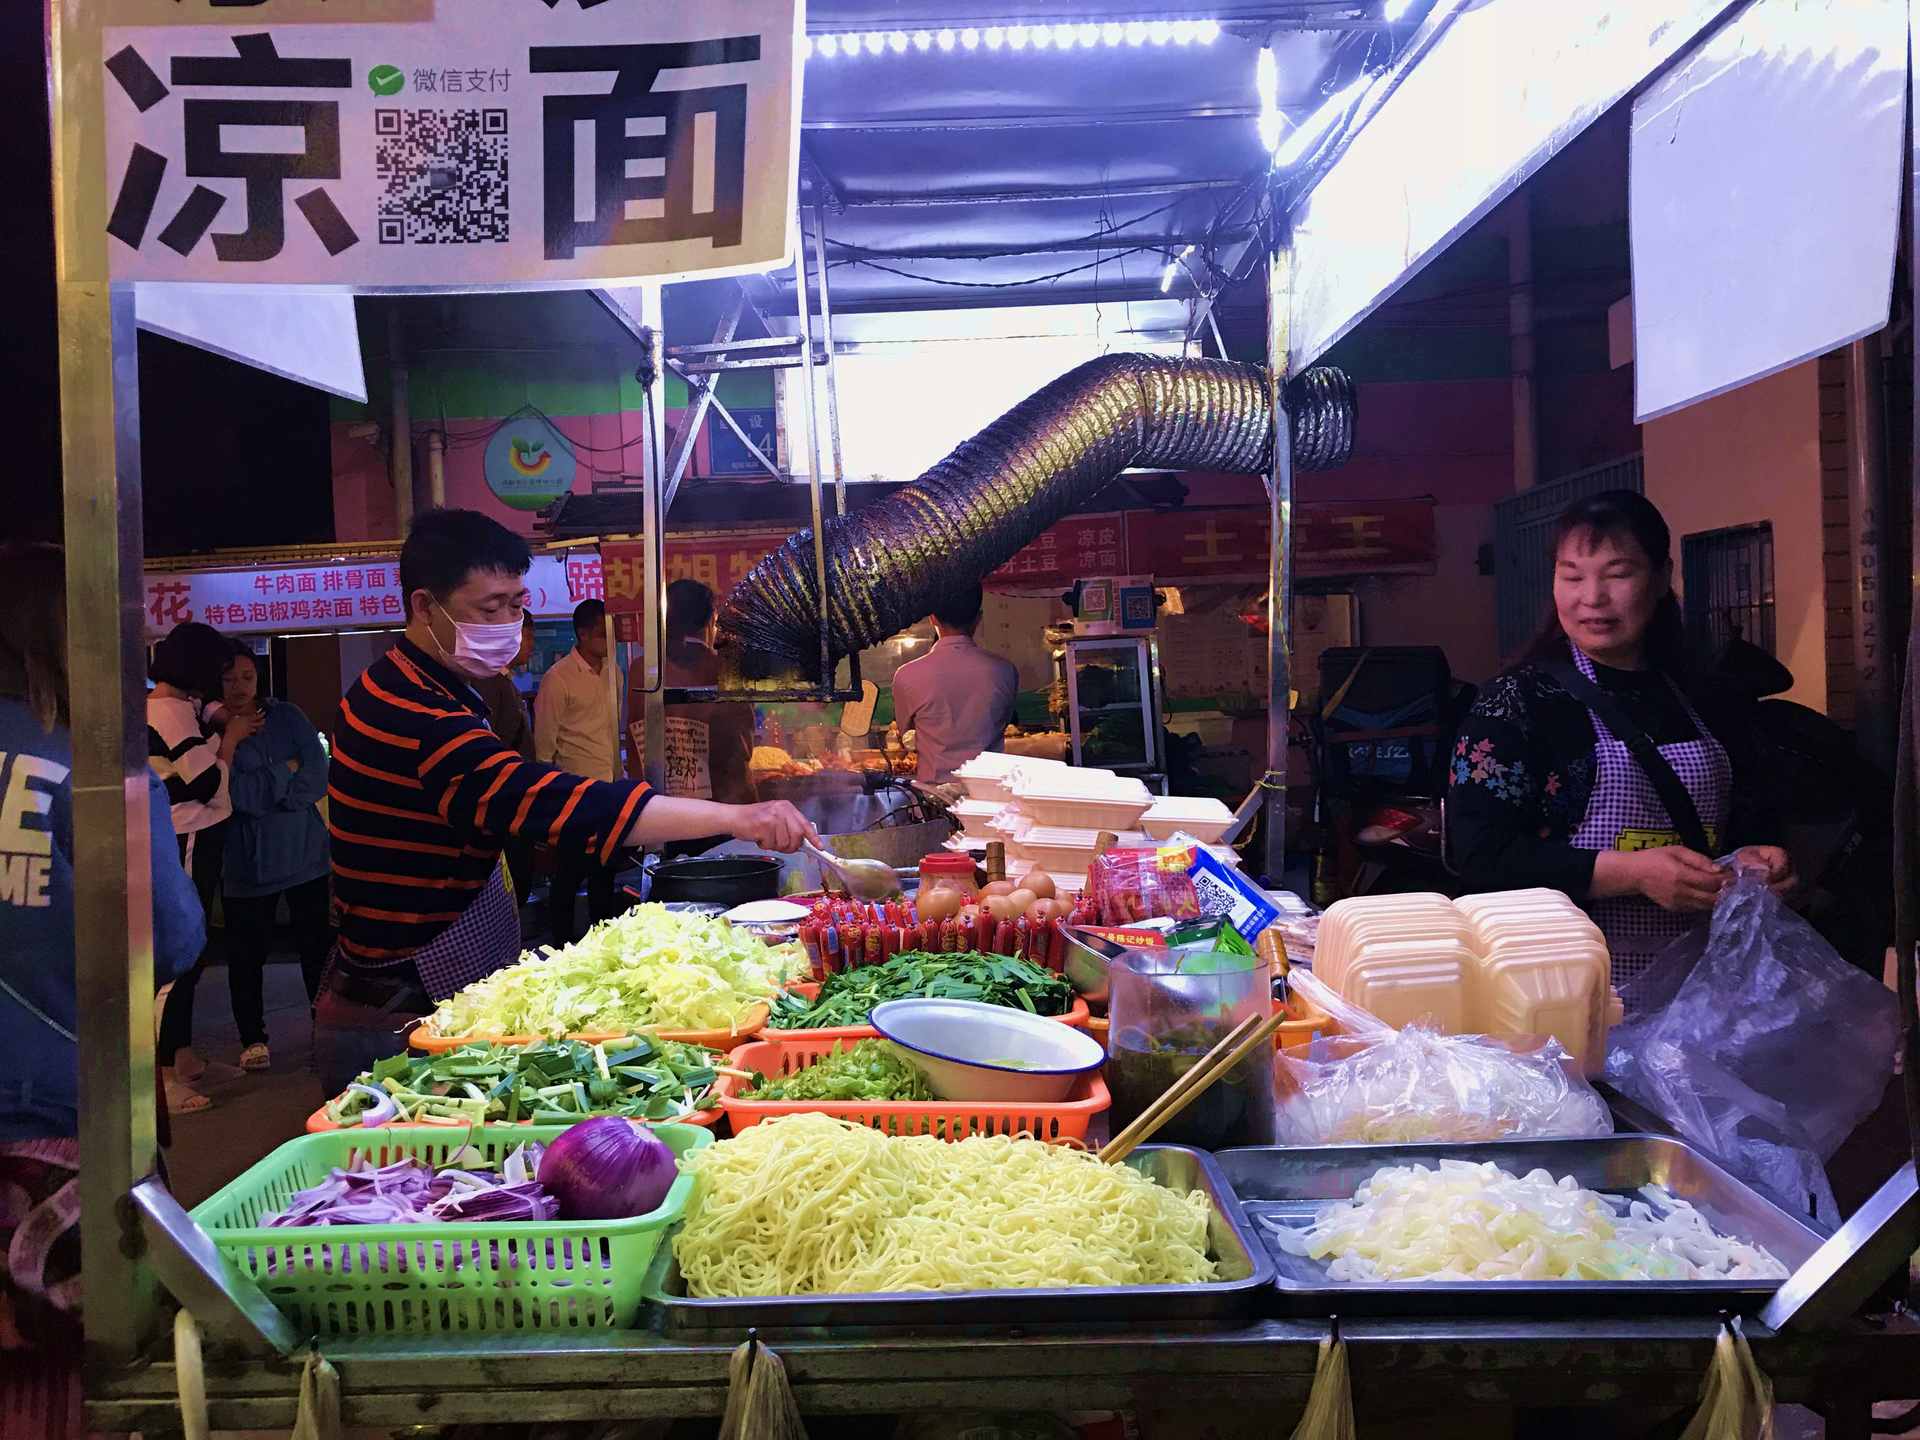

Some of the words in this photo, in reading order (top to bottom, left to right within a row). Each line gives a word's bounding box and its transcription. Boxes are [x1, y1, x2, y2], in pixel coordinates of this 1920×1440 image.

[412, 67, 512, 94] 微信支付
[254, 574, 317, 596] 牛肉面
[323, 568, 386, 592] 排骨面
[148, 582, 193, 625] 花
[204, 599, 353, 625] 特色泡椒鸡杂面
[359, 594, 402, 617] 特色
[0, 752, 70, 854] E
